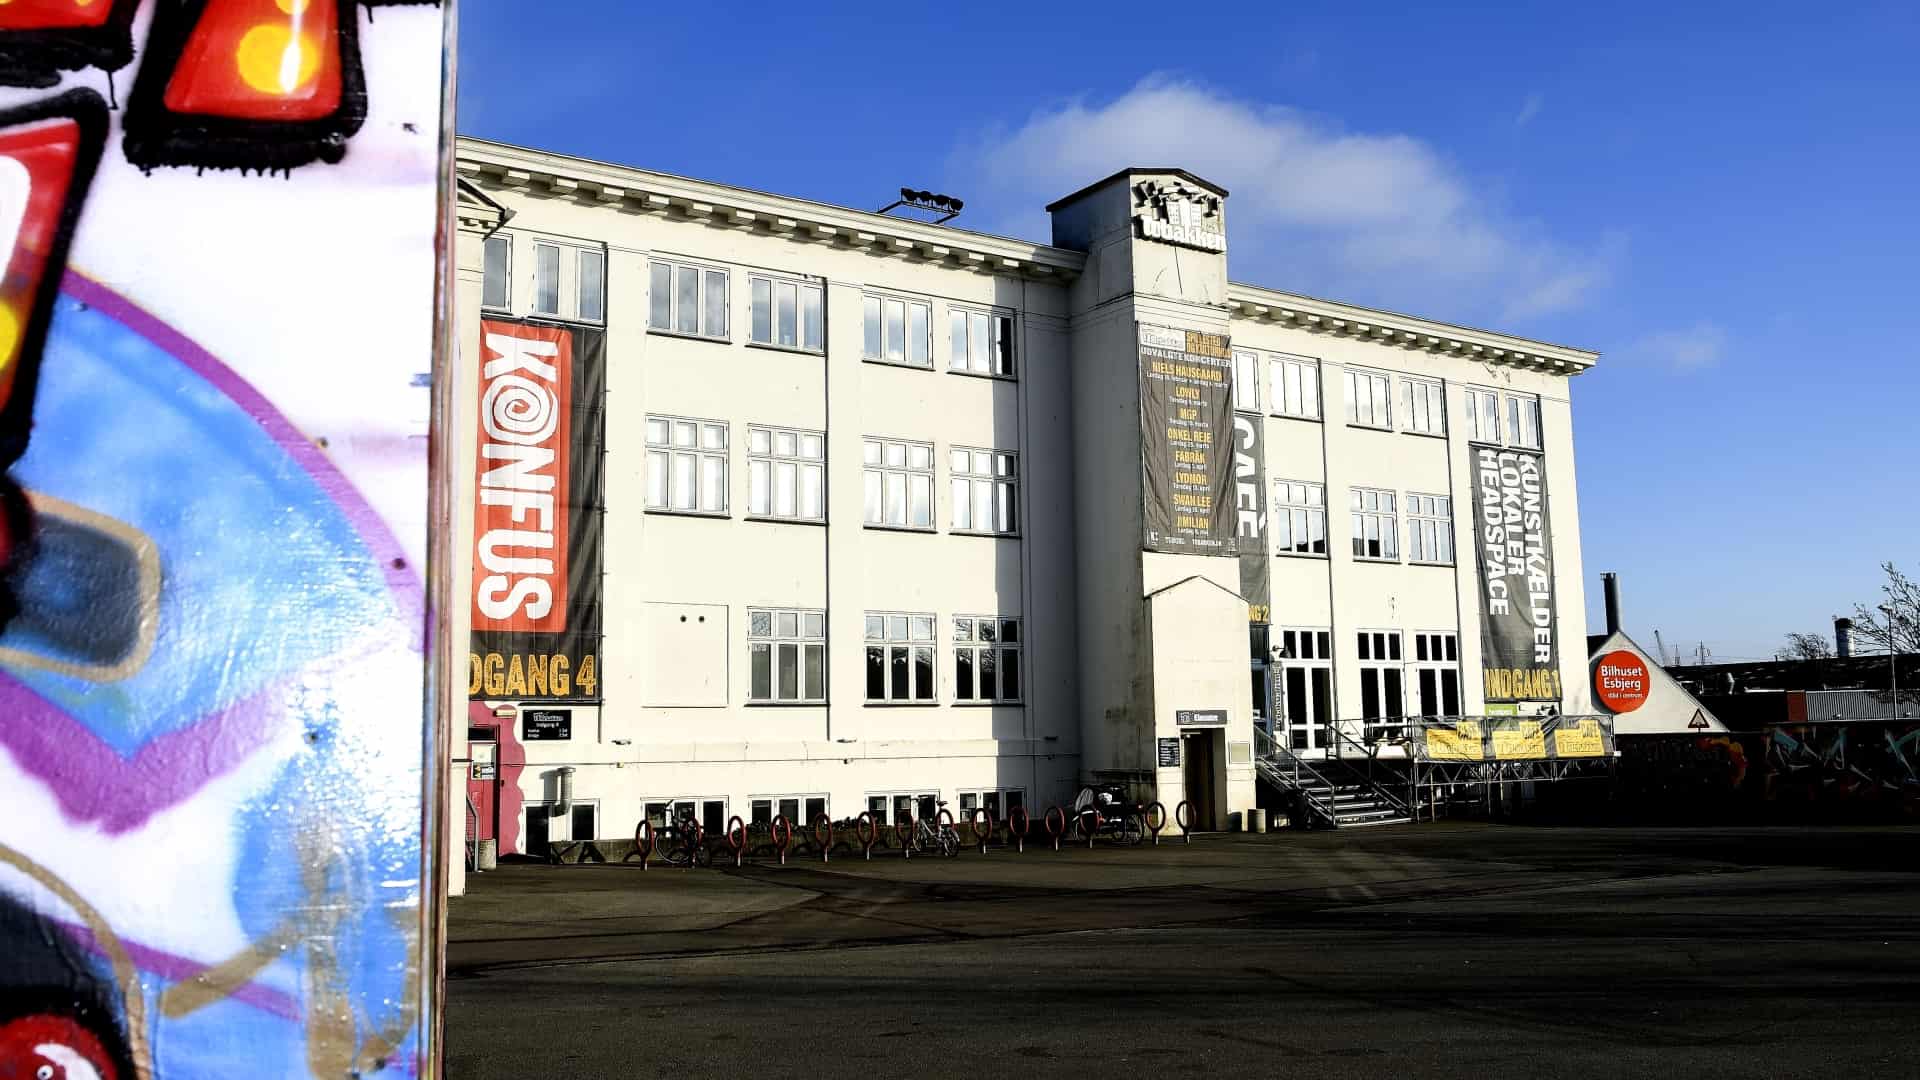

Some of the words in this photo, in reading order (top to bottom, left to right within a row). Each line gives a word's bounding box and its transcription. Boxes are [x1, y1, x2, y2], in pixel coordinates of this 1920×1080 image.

[1479, 449, 1509, 616] HEADSPACE
[1497, 452, 1525, 576] LOKALER
[1519, 453, 1551, 663] KUNSTKÆLDER
[469, 652, 570, 696] DGANG
[576, 654, 597, 696] 4
[1484, 668, 1552, 699] INDGANG
[1601, 665, 1642, 677] Bilhuset
[1603, 677, 1641, 691] Esbjerg
